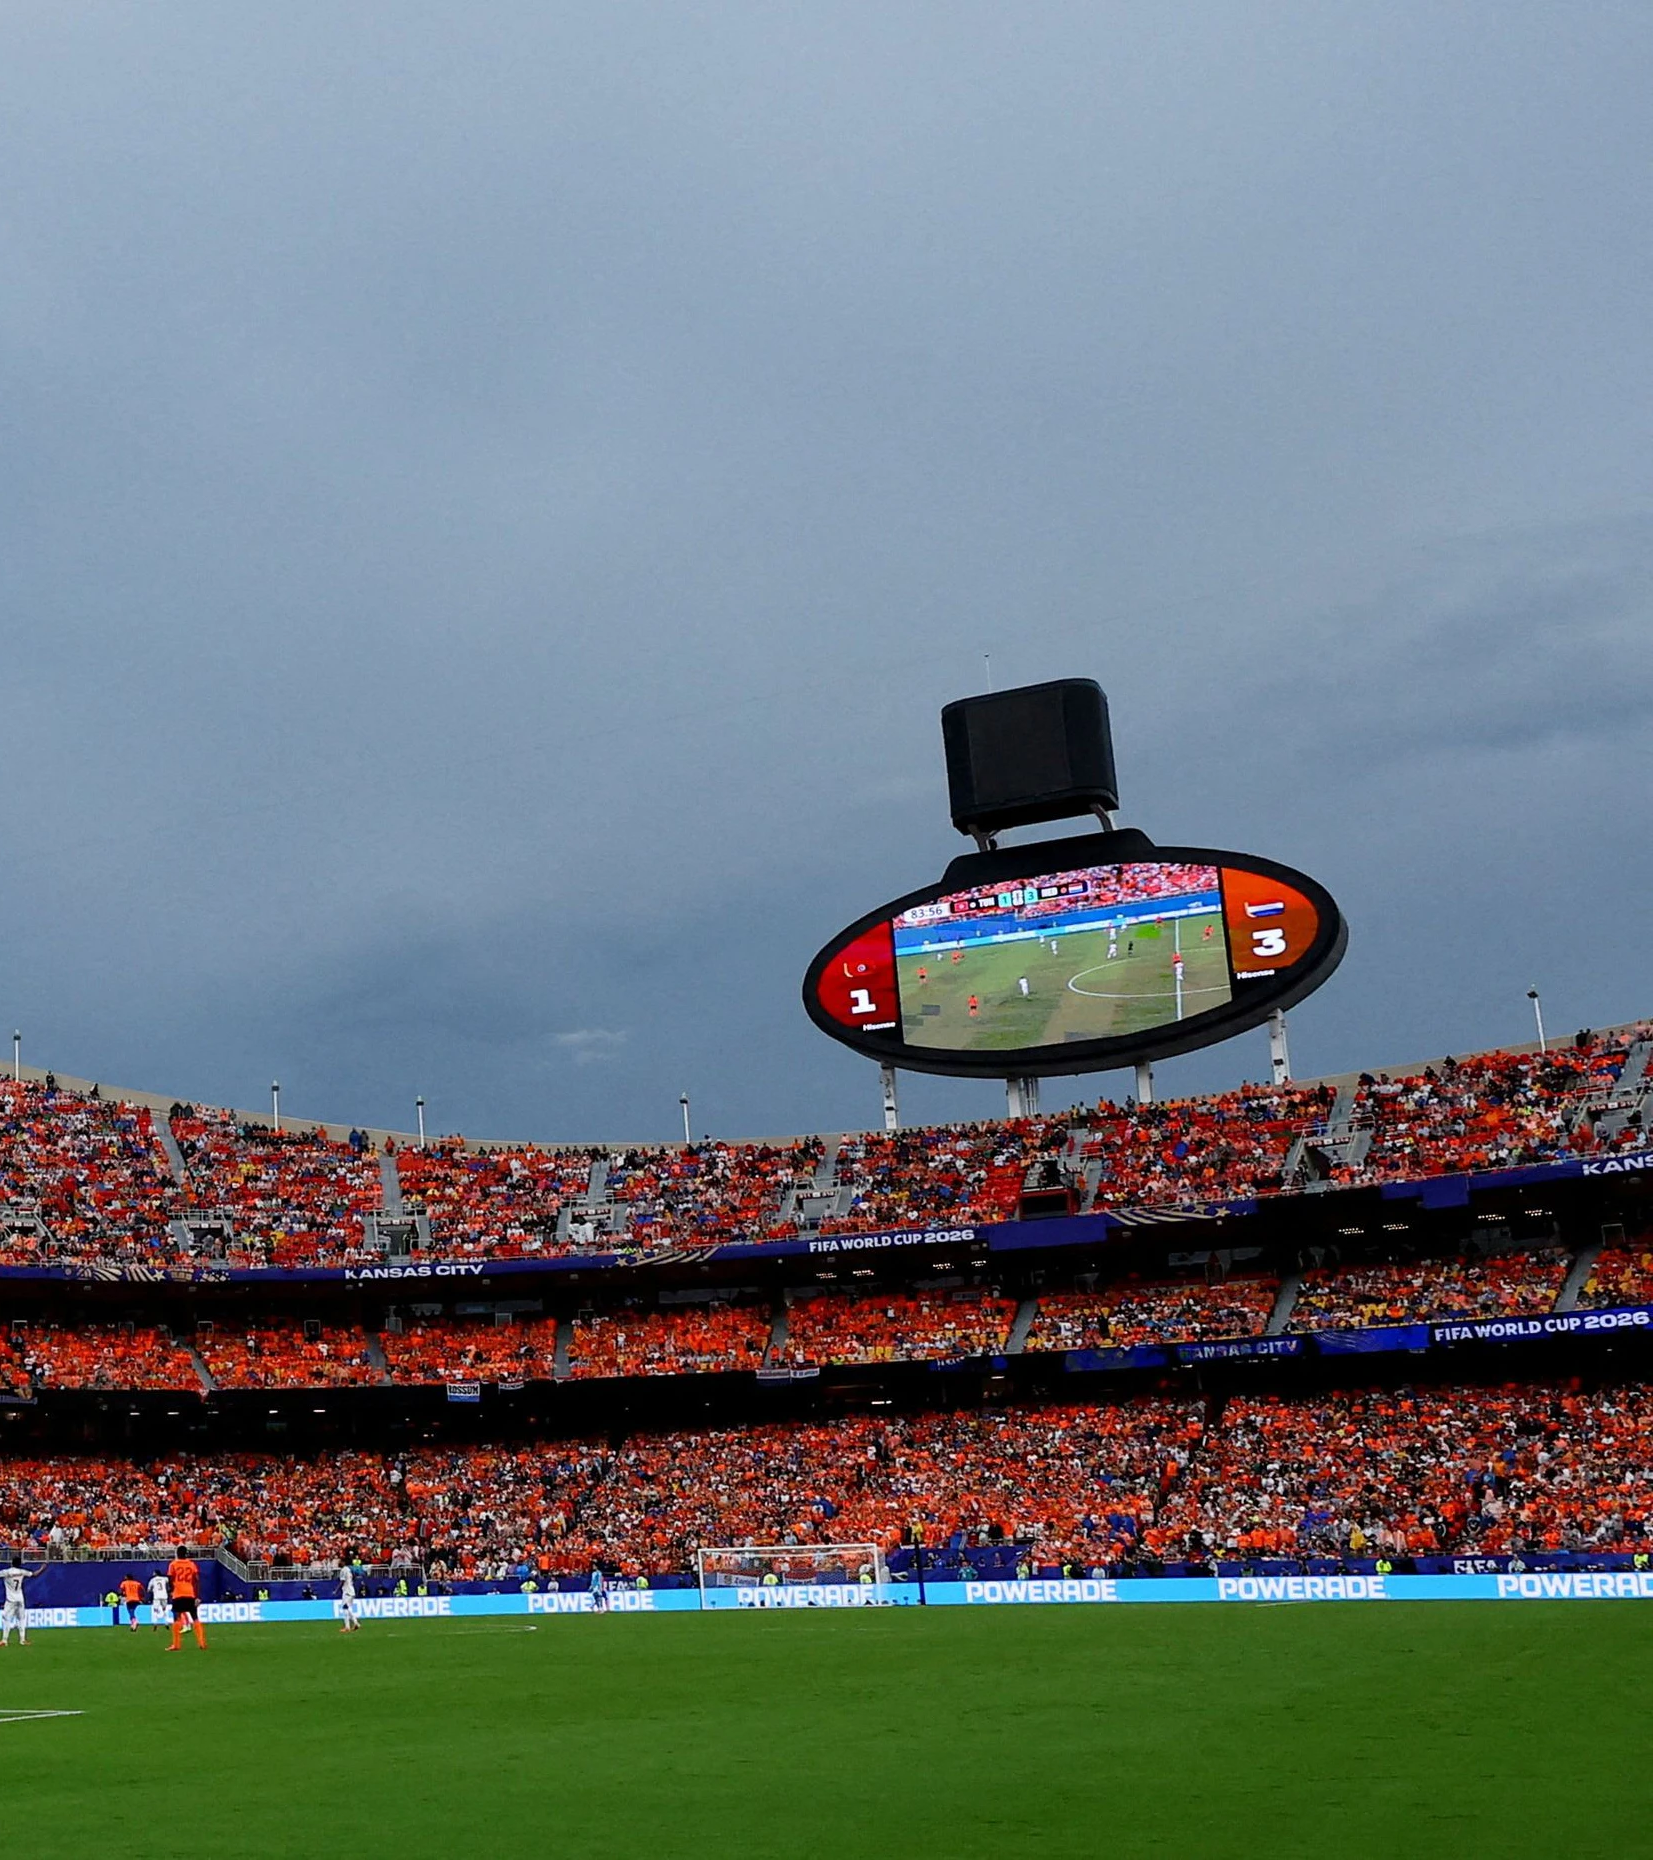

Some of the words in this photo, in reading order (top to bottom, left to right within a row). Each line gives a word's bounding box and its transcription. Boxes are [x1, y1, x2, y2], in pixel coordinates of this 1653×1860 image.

[910, 906, 943, 920] 83:56
[1252, 928, 1286, 957] 3
[850, 988, 876, 1014] 1
[809, 1240, 839, 1253] FIFA
[841, 1235, 892, 1250] WORLD
[893, 1232, 922, 1246] CUP
[924, 1229, 975, 1244] 2026
[345, 1266, 432, 1280] KANSAS
[435, 1264, 484, 1276] CITY
[1434, 1327, 1473, 1342] FIFA
[1474, 1320, 1542, 1339] WORLD
[1544, 1318, 1581, 1333] CUP
[1584, 1311, 1650, 1330] 2026
[1256, 1340, 1297, 1355] CITY
[13, 1579, 20, 1591] 7
[176, 1566, 193, 1582] 22
[157, 1581, 164, 1591] 3
[737, 1584, 874, 1606] POWERADE
[965, 1580, 1117, 1603] POWERADE
[1218, 1576, 1385, 1600] POWERADE
[528, 1589, 654, 1614] POWEADE
